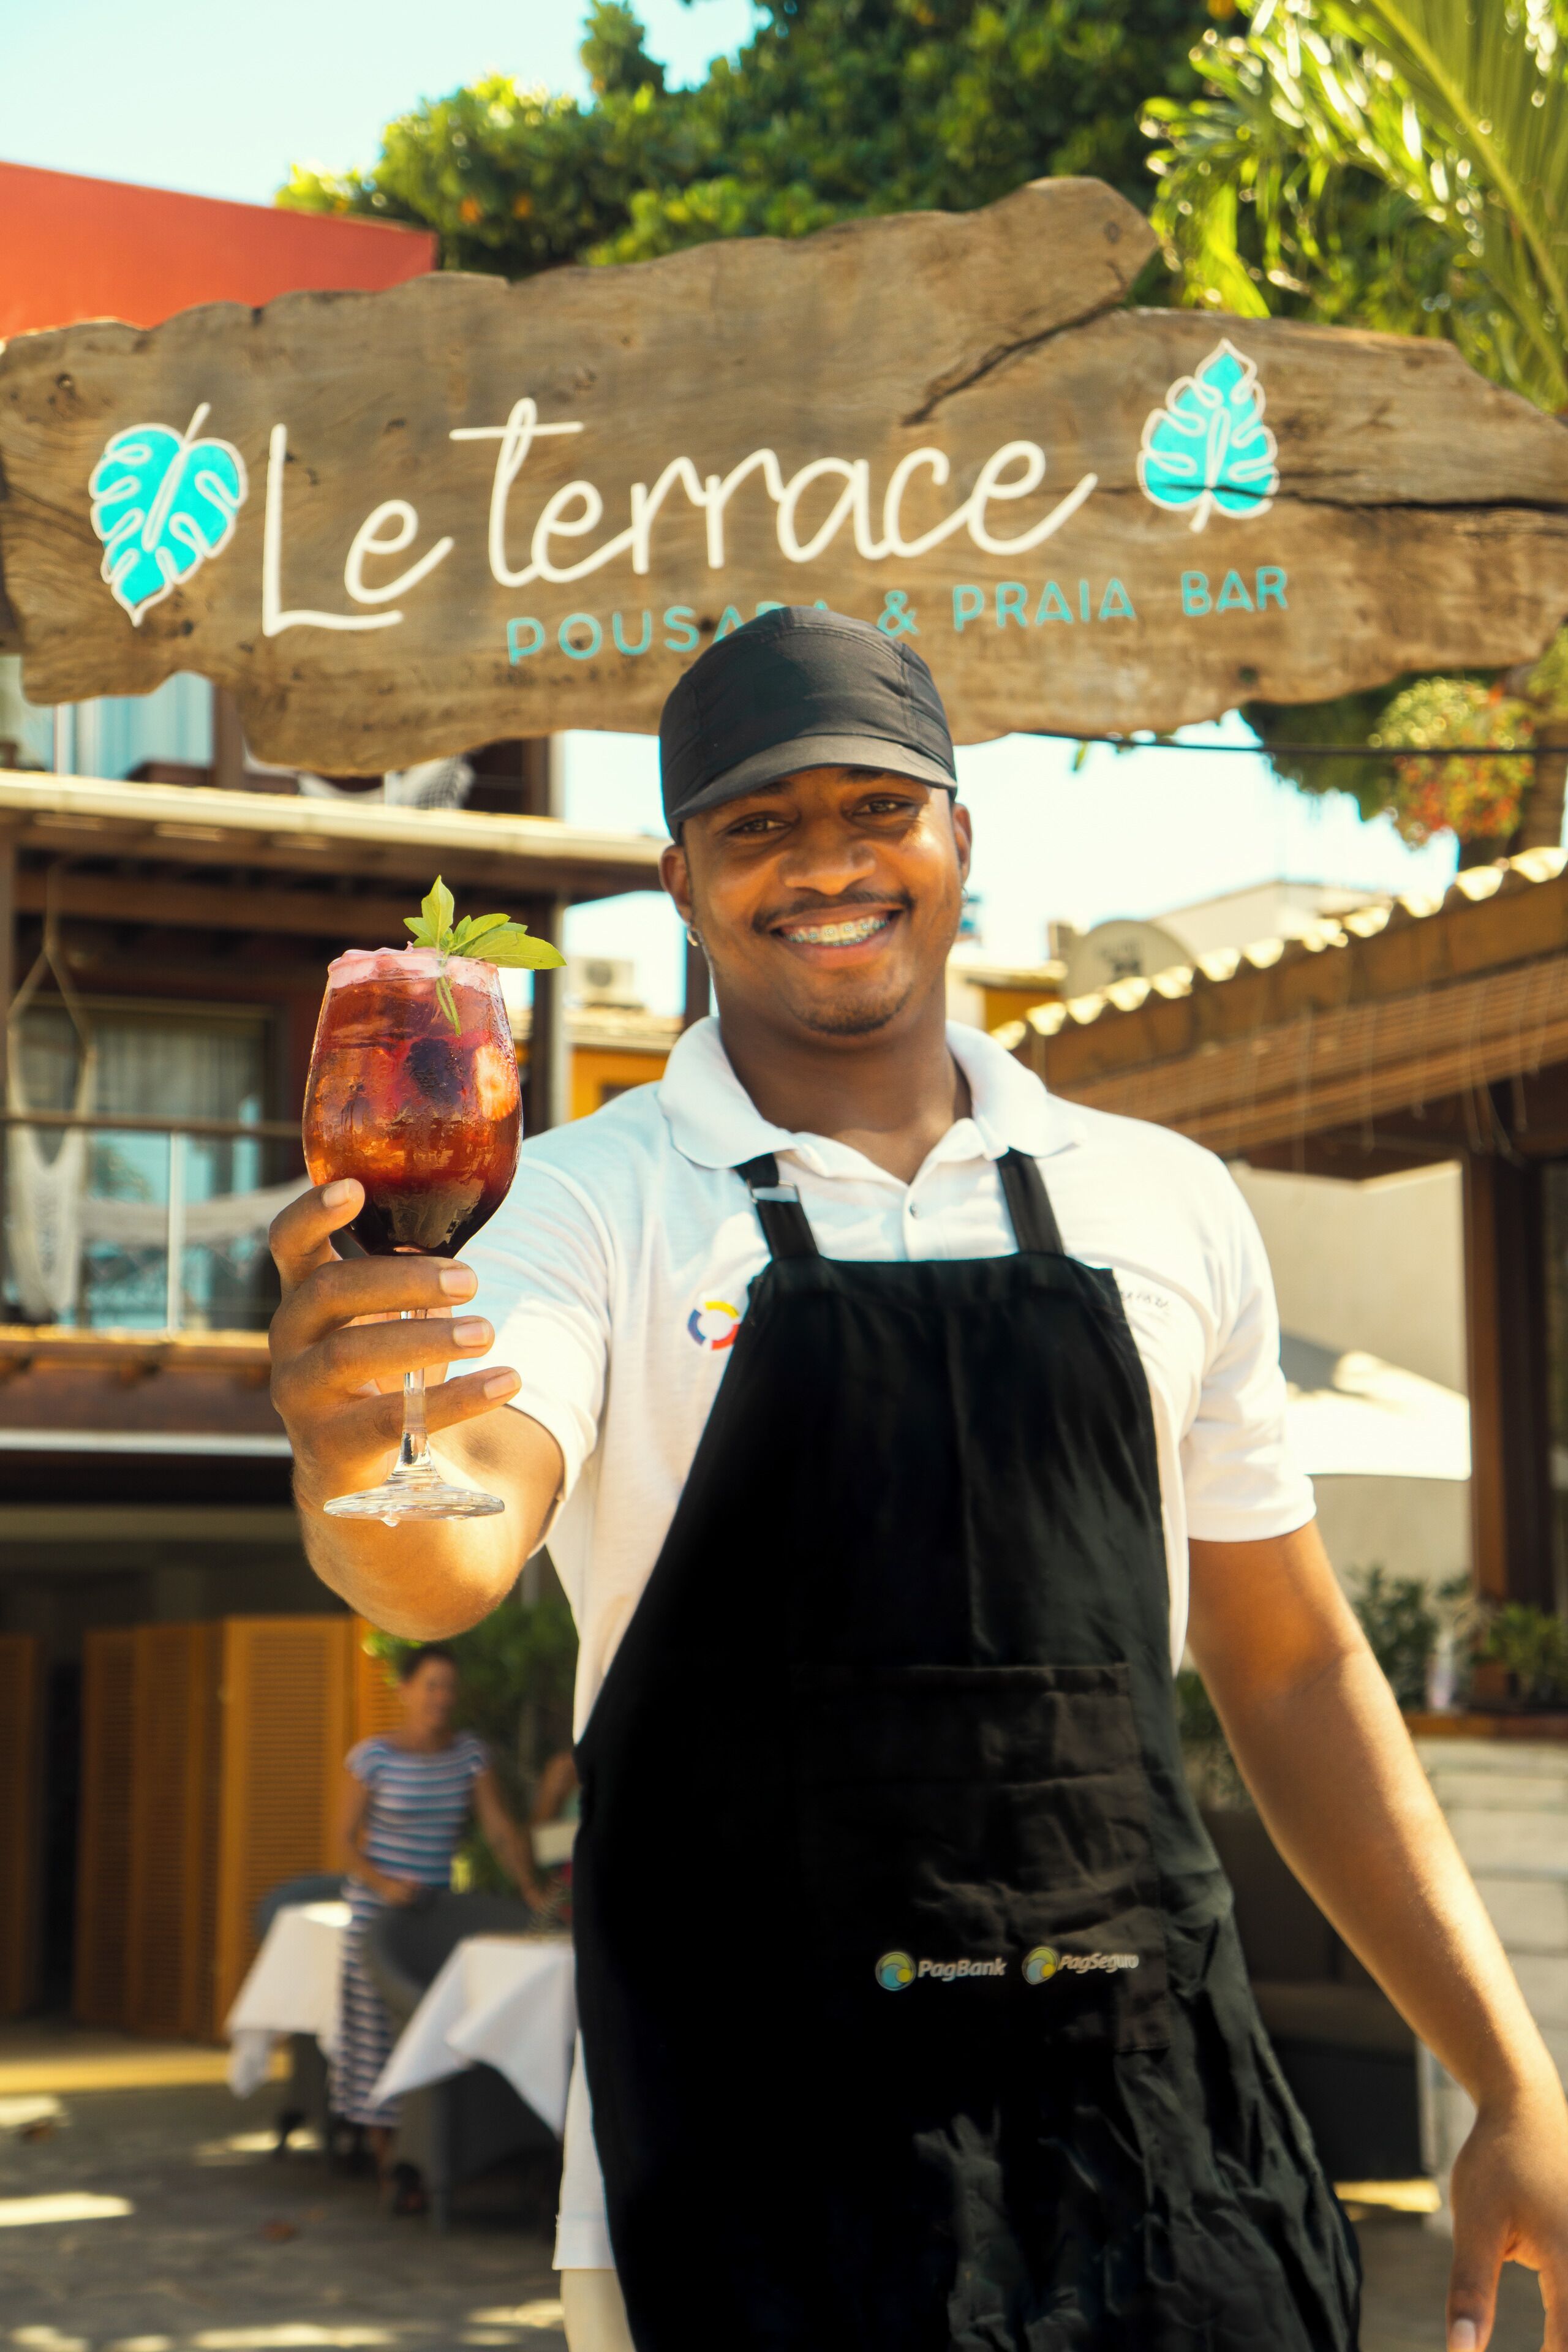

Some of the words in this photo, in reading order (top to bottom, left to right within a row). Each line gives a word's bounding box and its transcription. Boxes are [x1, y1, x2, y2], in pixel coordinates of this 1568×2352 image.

[262, 423, 454, 637] Le
[448, 397, 1098, 588] terrace
[507, 600, 828, 666] POUSA
[878, 590, 919, 637] &
[952, 577, 1135, 631] PRAIA
[1181, 565, 1287, 616] BAR
[918, 1958, 1008, 1981] PagBank
[1057, 1952, 1139, 1974] PagSeguro
